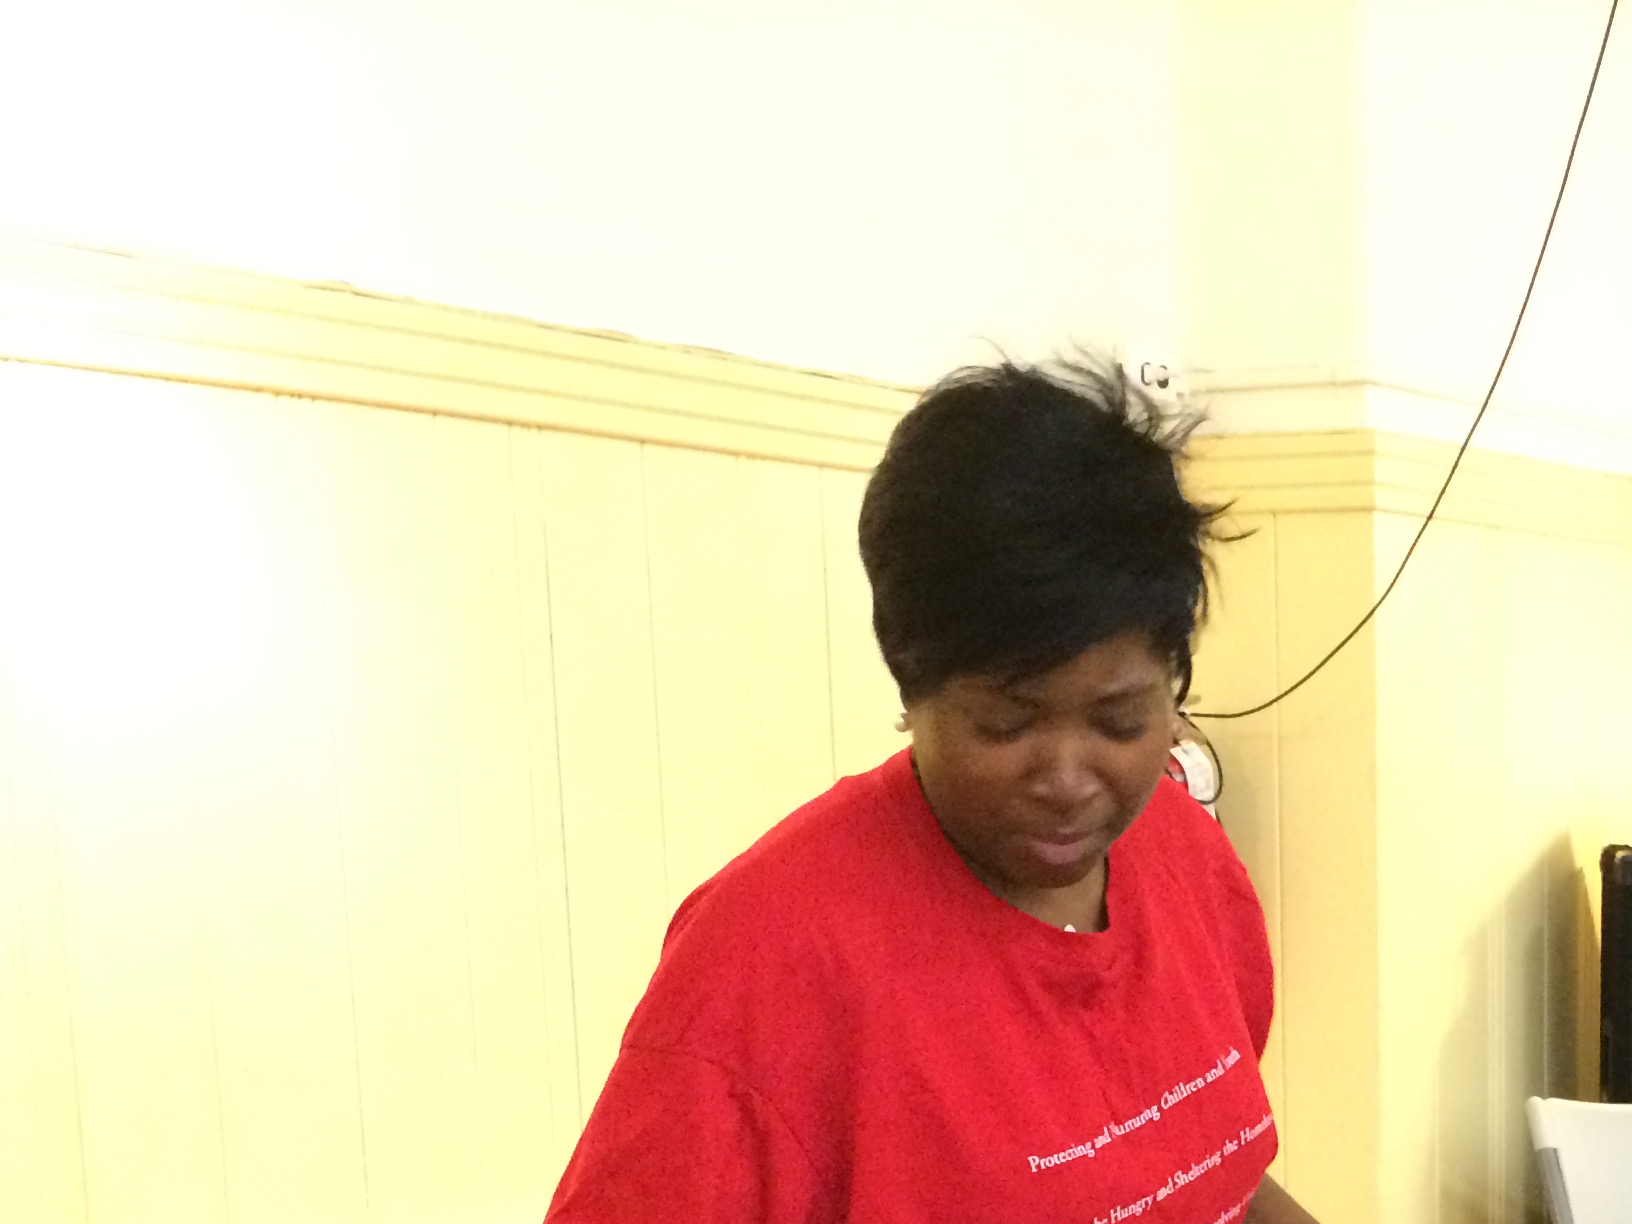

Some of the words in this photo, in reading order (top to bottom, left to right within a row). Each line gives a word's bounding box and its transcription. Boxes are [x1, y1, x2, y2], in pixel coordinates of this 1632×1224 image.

[1028, 1140, 1096, 1172] Protecting
[1092, 1127, 1112, 1150] and
[1110, 1104, 1161, 1138] Nurturing
[1161, 1077, 1205, 1110] Children
[1205, 1059, 1225, 1083] and
[1110, 1195, 1154, 1224] Hungry
[1156, 1178, 1175, 1202] and
[1174, 1148, 1223, 1189] Sheltering
[1223, 1139, 1239, 1156] the
